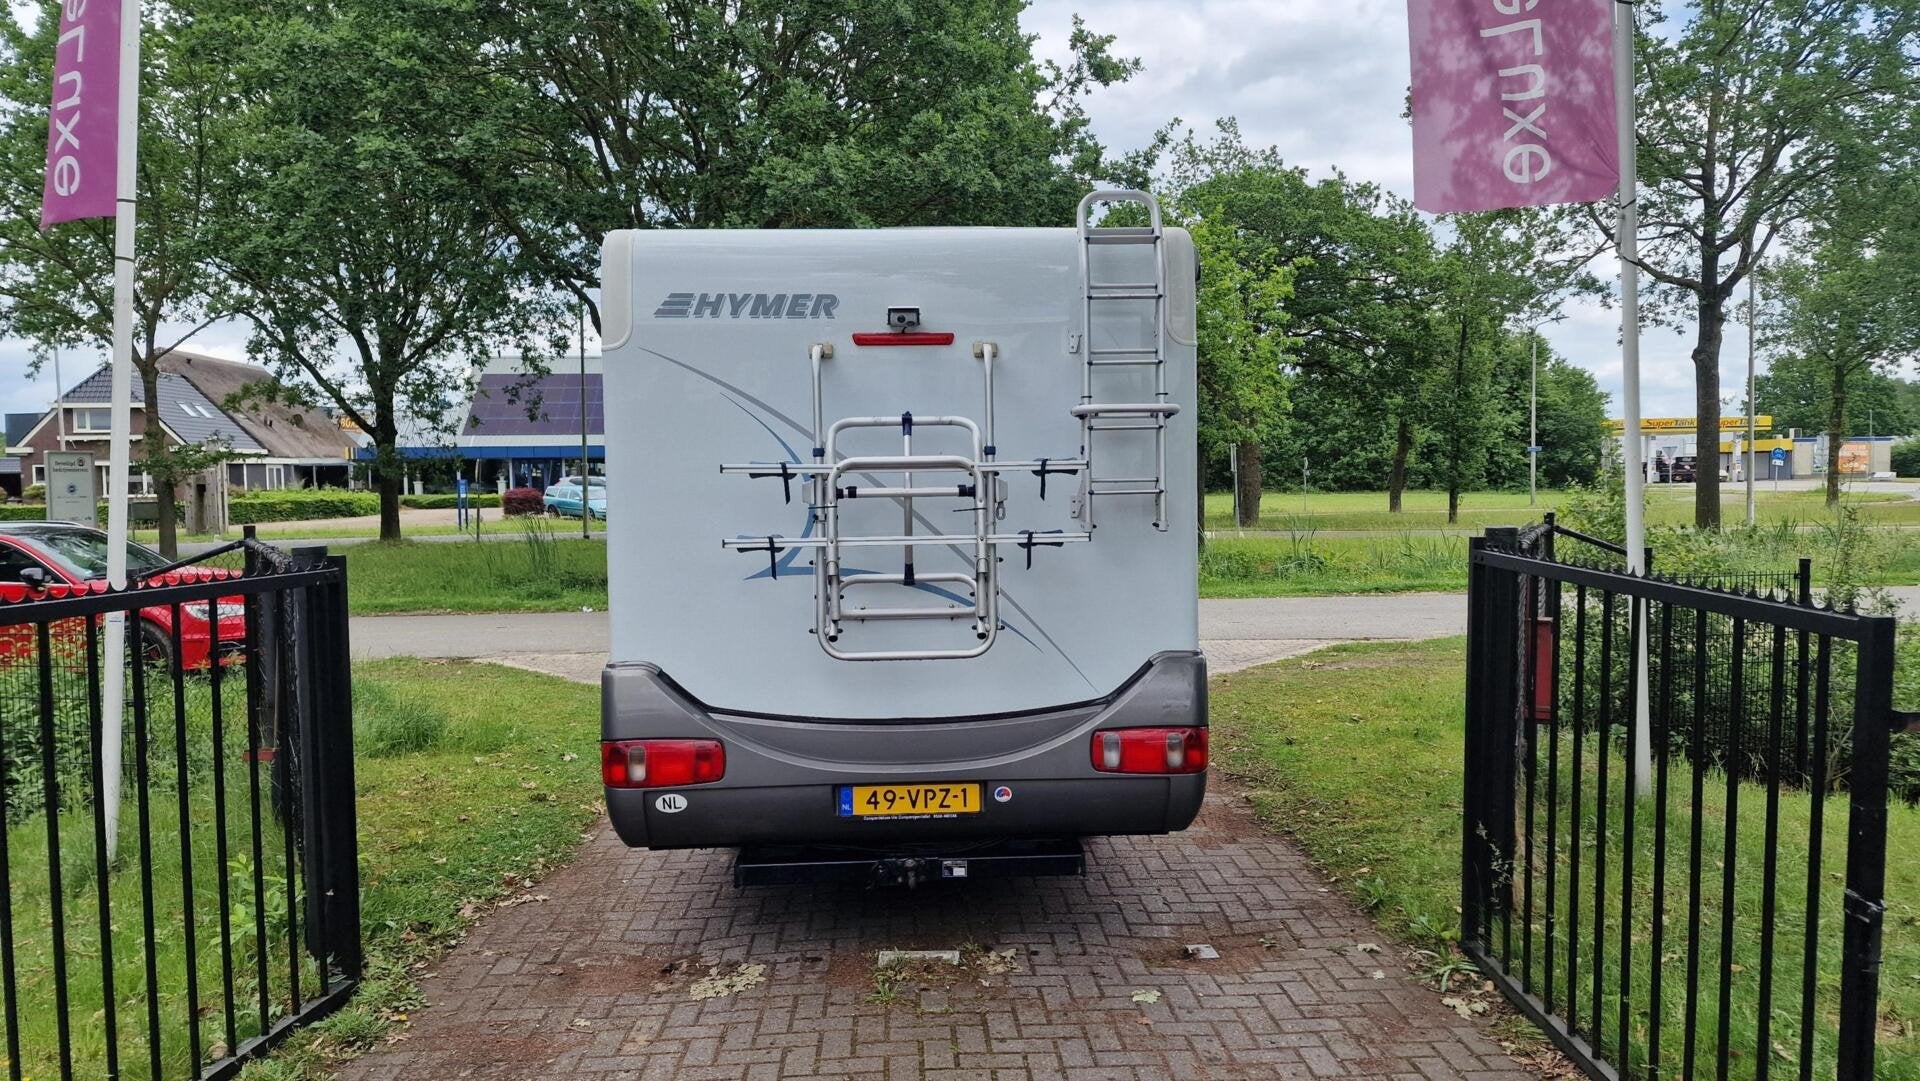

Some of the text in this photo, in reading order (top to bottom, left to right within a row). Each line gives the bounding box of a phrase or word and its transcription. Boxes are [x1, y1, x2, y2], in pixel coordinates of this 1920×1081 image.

[693, 293, 840, 320] HYMER
[1646, 419, 1697, 430] SuperTank
[661, 796, 682, 810] NL
[865, 787, 968, 811] 49-VPZ-1
[841, 803, 852, 811] NL
